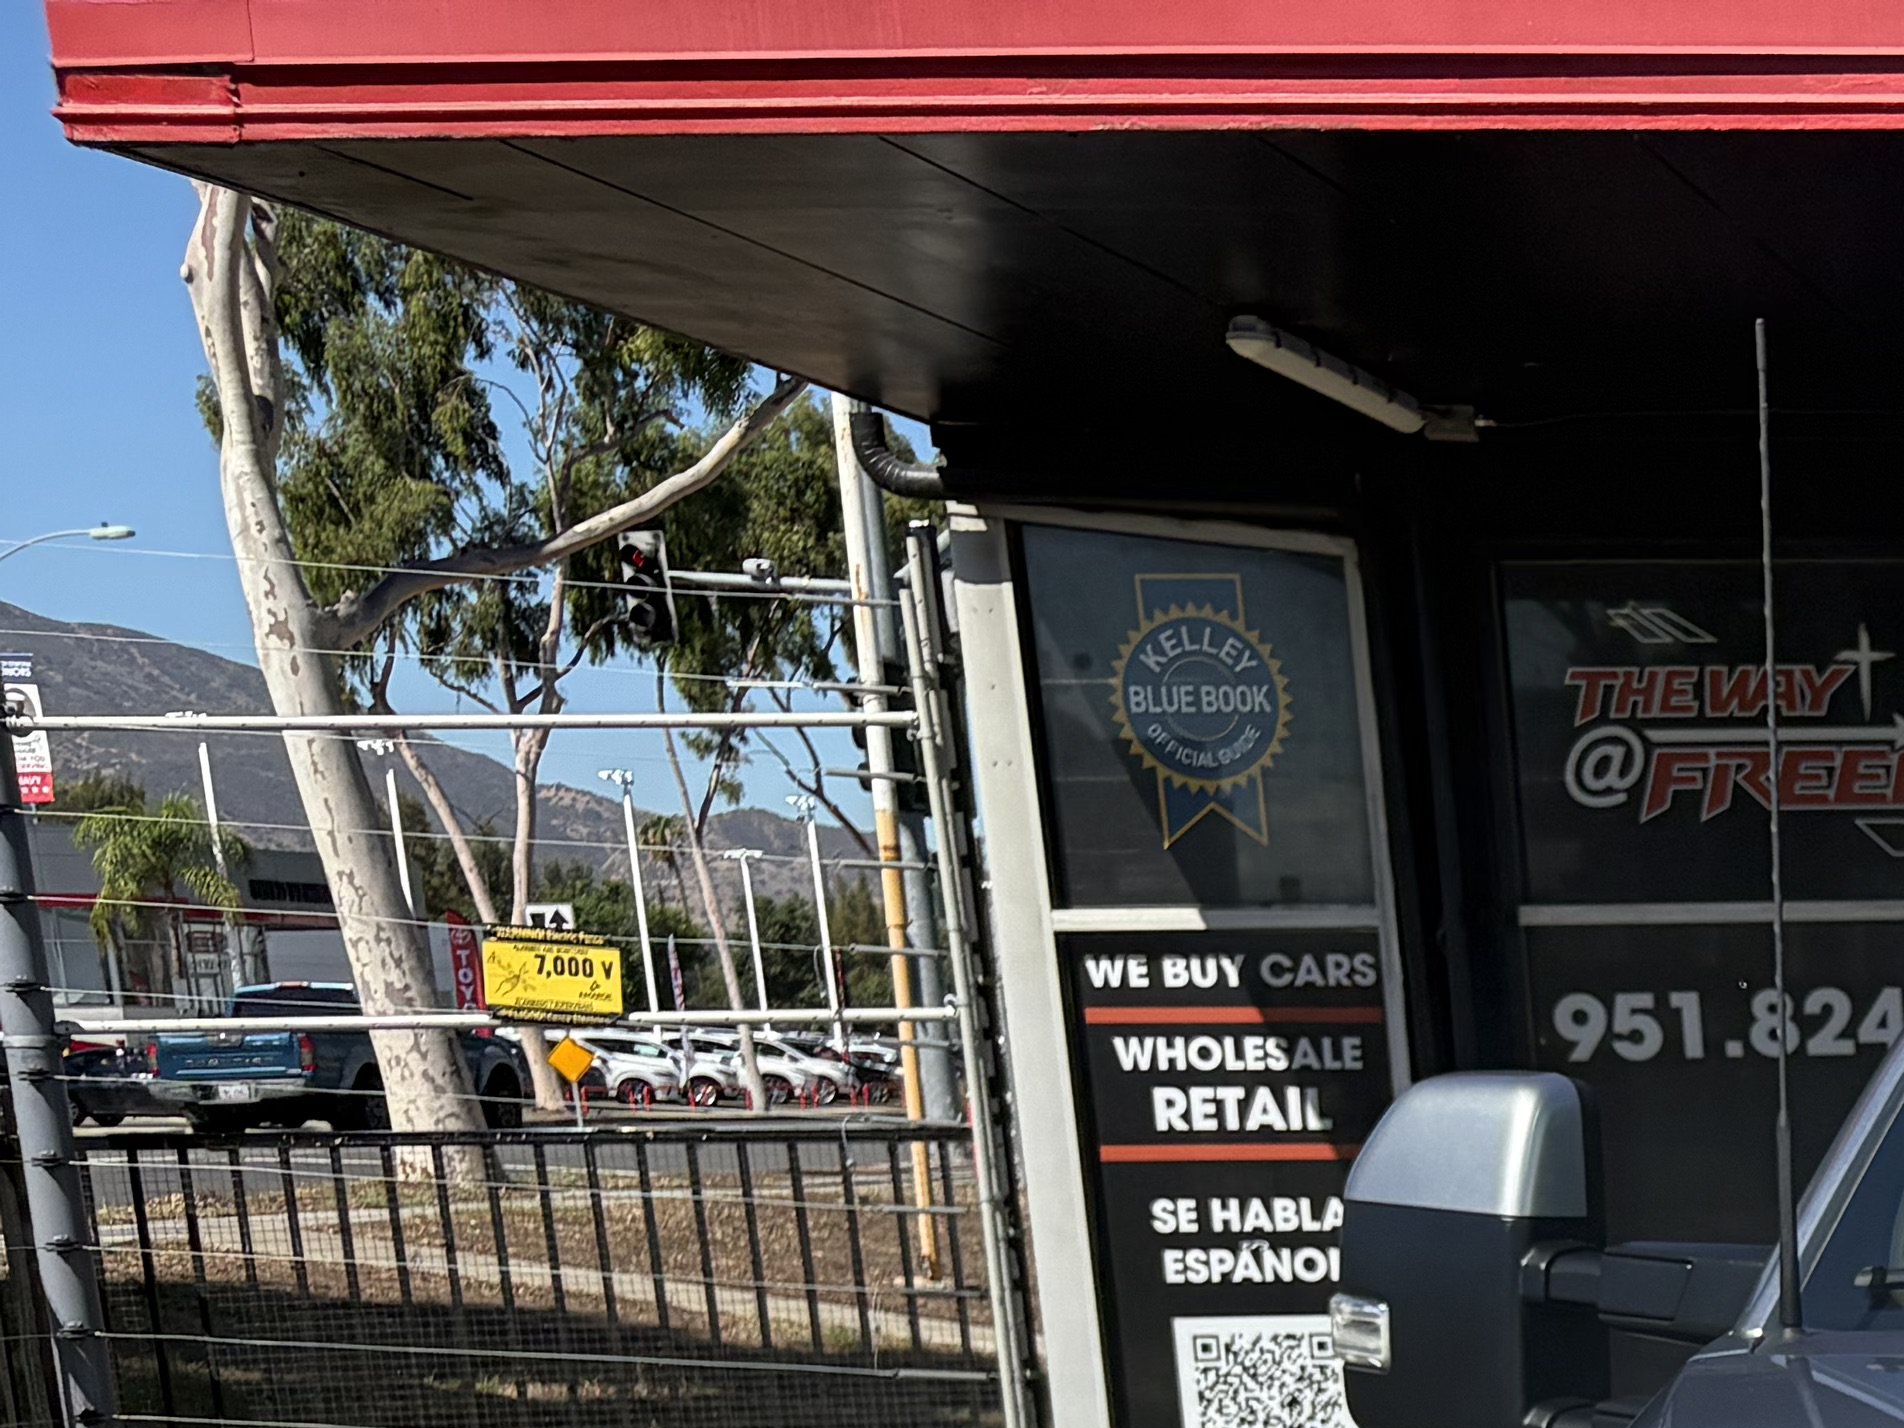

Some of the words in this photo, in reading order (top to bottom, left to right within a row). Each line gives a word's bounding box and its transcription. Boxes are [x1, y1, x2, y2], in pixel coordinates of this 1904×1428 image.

[1140, 626, 1259, 672] KELLEY
[1130, 685, 1196, 714] BLUE
[1201, 685, 1272, 713] BOOK
[1565, 665, 1702, 727] THE
[1704, 665, 1858, 717] WAY
[1148, 723, 1218, 769] OFFICIAL
[1218, 723, 1261, 765] GUIDE
[533, 953, 594, 980] 7,000
[601, 960, 614, 981] V
[1085, 955, 1150, 988] WE
[1162, 953, 1245, 988] BUY
[1260, 953, 1377, 987] CARS
[1114, 1036, 1364, 1070] WHOLESALE
[1152, 1086, 1333, 1132] RETAIL
[1151, 1198, 1198, 1234] SE
[1211, 1198, 1344, 1233] HABLA
